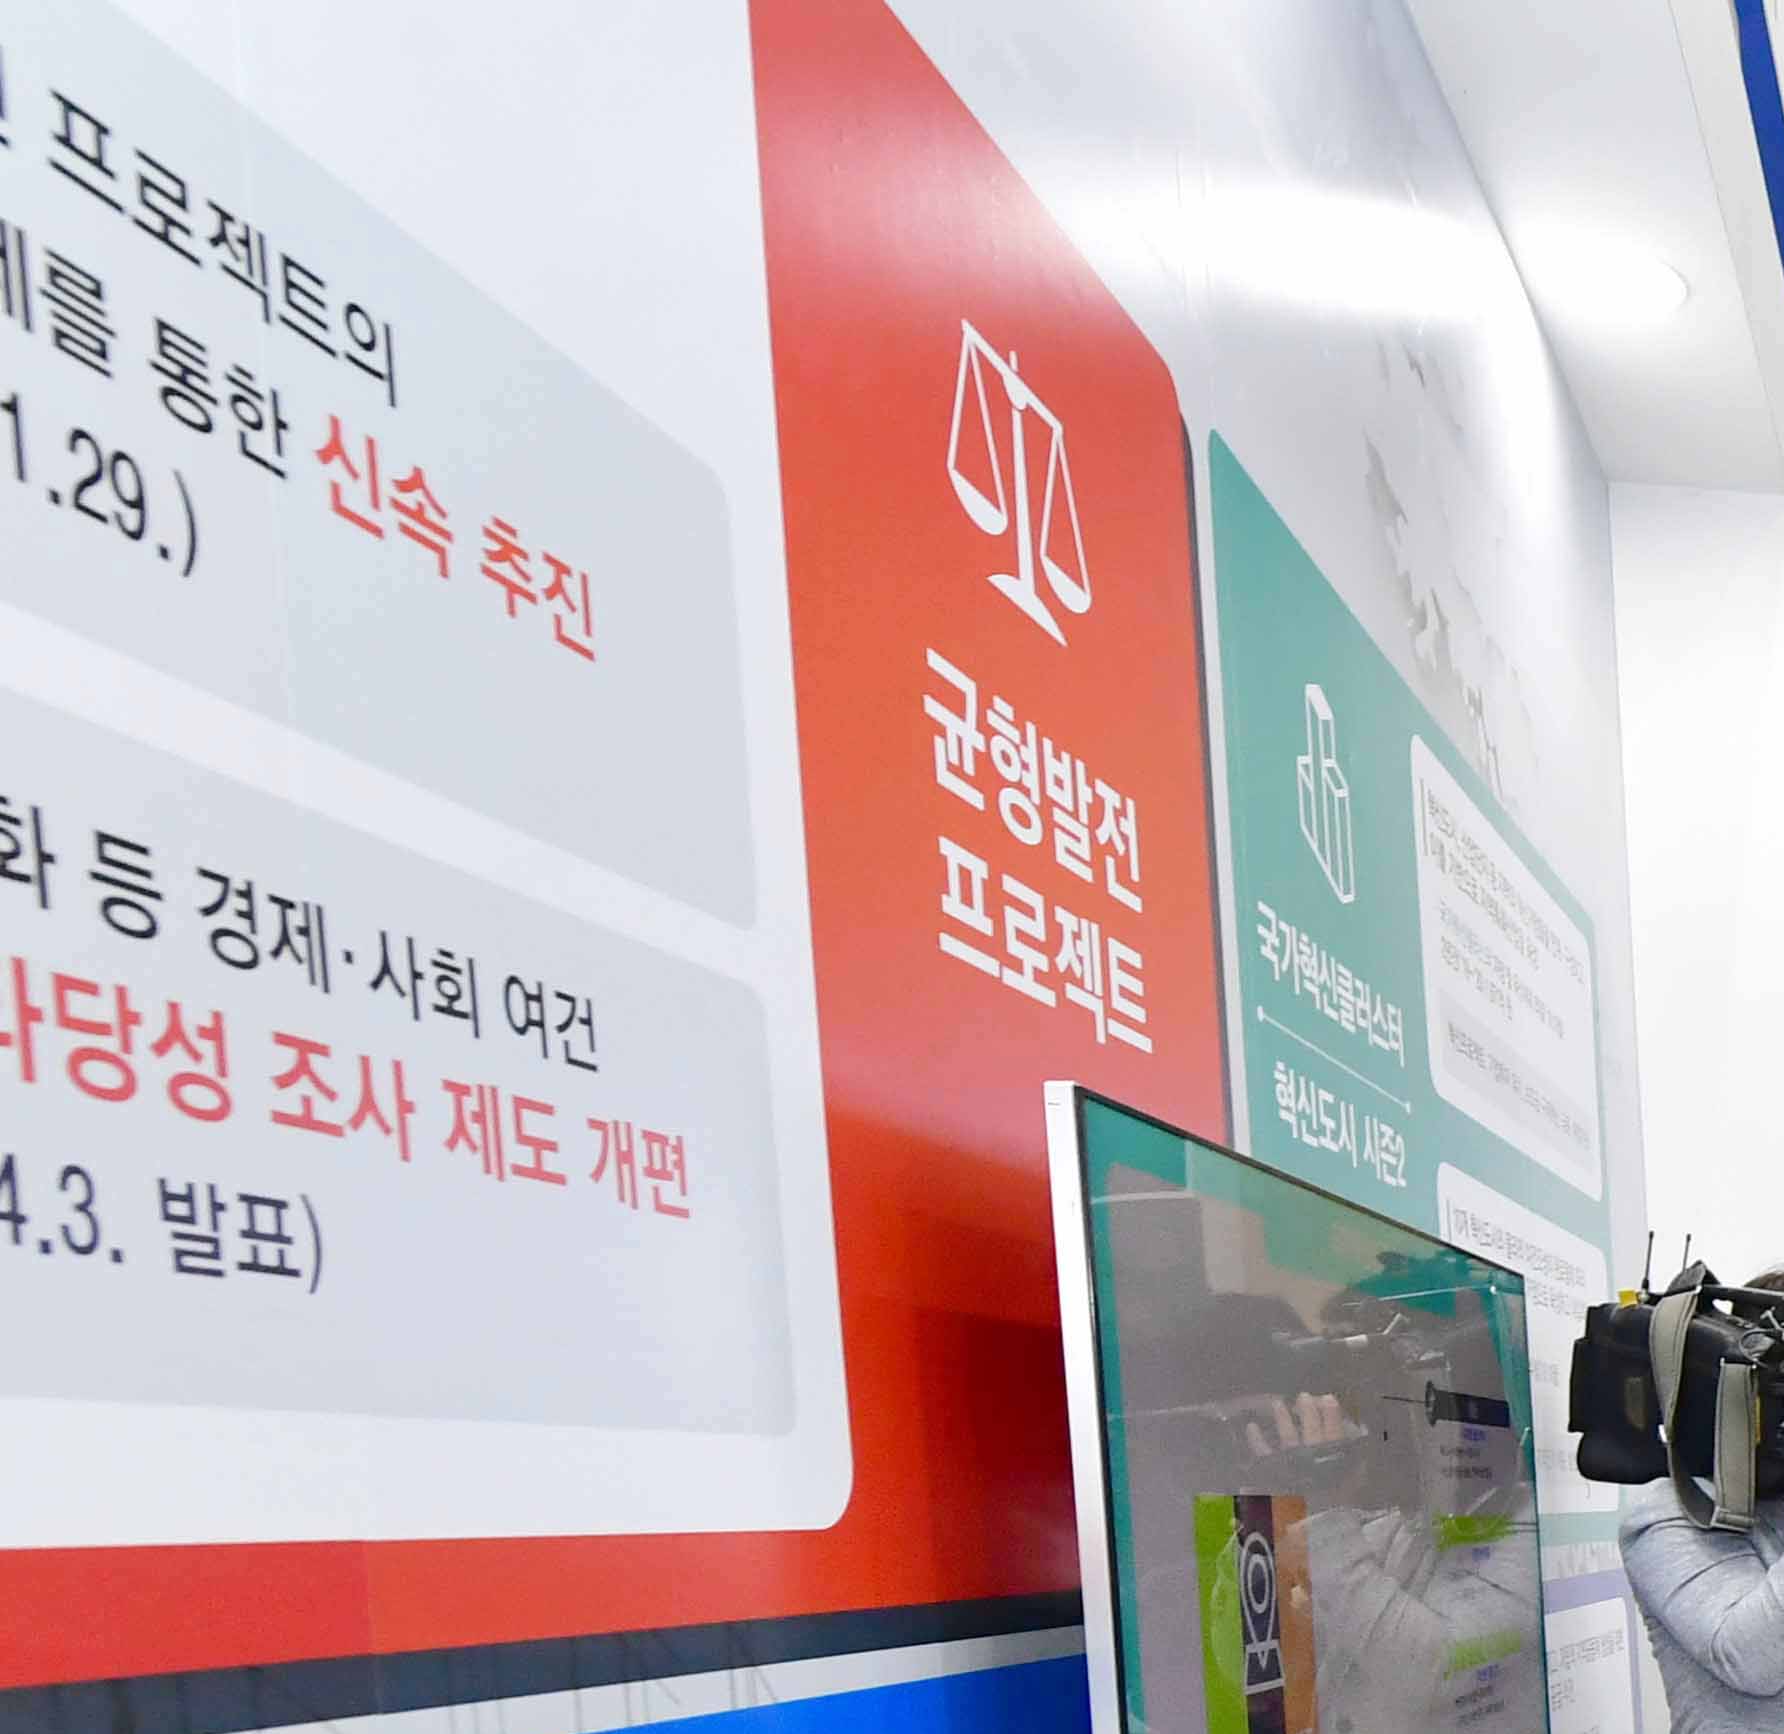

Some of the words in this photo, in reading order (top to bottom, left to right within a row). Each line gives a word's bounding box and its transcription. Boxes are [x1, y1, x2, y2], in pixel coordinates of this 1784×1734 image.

[48, 88, 398, 408] 프로젝트의
[149, 316, 289, 480] 통한
[314, 413, 455, 581] 신속
[480, 516, 597, 663] 추진
[922, 646, 1143, 913] 균형발전
[89, 830, 164, 940] 등
[503, 972, 600, 1072] 여건
[938, 834, 1152, 1054] 프로젝트
[1257, 901, 1405, 1068] 국가혁신클러스터
[270, 1030, 415, 1164] 조사
[441, 1078, 568, 1187] 제도
[586, 1116, 692, 1220] 개편
[1274, 1062, 1358, 1170] 혁신도시
[158, 1178, 323, 1294] 발표)
